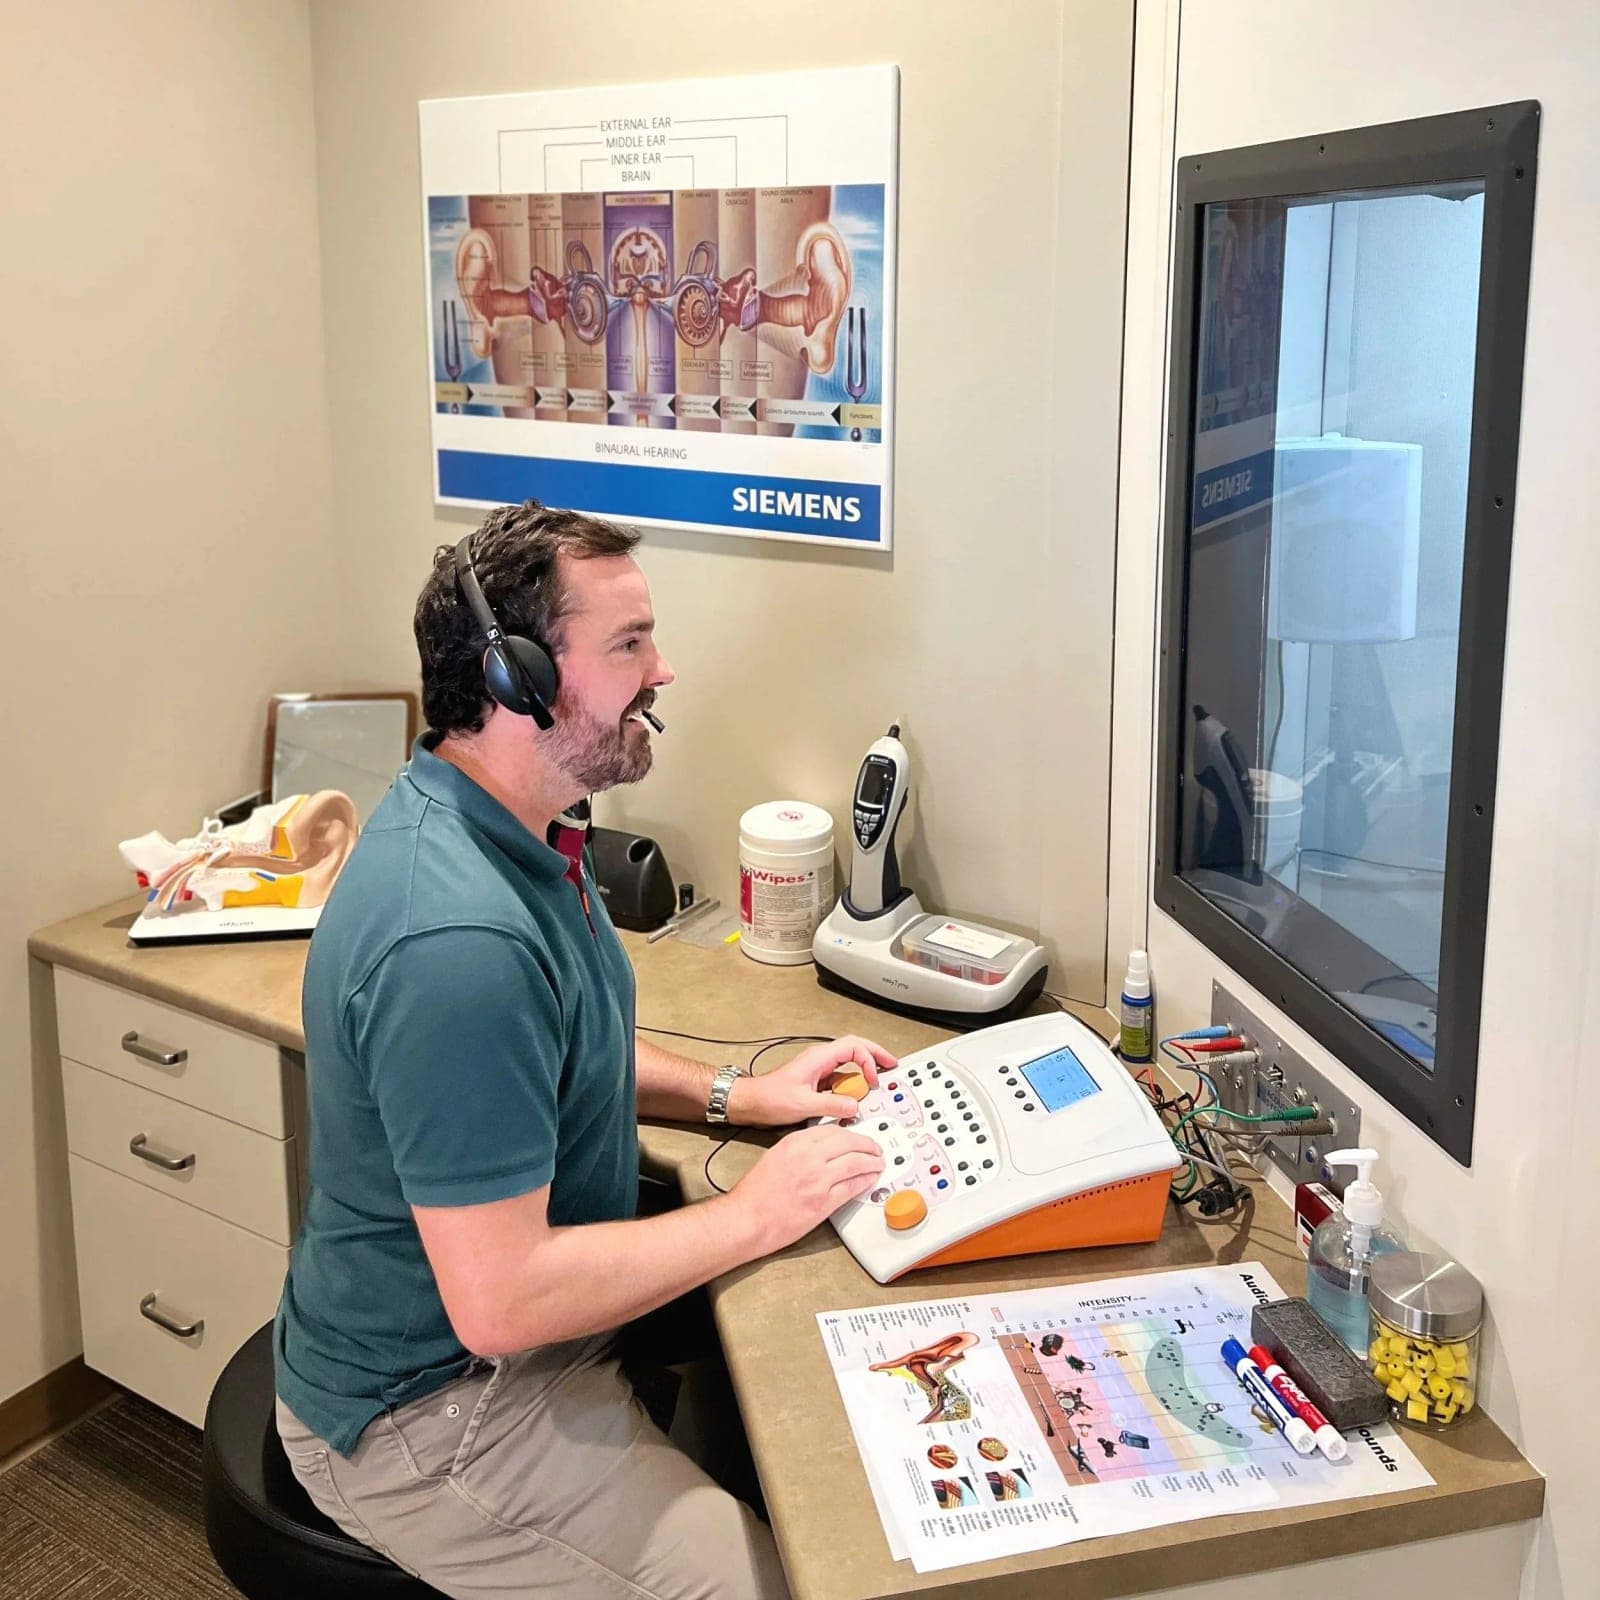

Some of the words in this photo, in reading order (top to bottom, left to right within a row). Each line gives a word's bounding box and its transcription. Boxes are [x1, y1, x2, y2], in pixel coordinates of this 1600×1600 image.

[600, 118, 649, 132] EXTERNAL
[652, 116, 672, 129] EAR
[606, 135, 644, 148] MIDDLE
[646, 134, 666, 147] EAR
[611, 153, 640, 166] INNER
[642, 152, 661, 164] EAR
[621, 169, 651, 182] BRAIN
[595, 442, 641, 457] BINAURAL
[643, 446, 687, 460] HEARING
[732, 487, 862, 523] SIEMENS
[1078, 1295, 1132, 1308] INTENSITY
[1239, 1273, 1270, 1305] Audio
[1358, 1428, 1399, 1473] ounds
